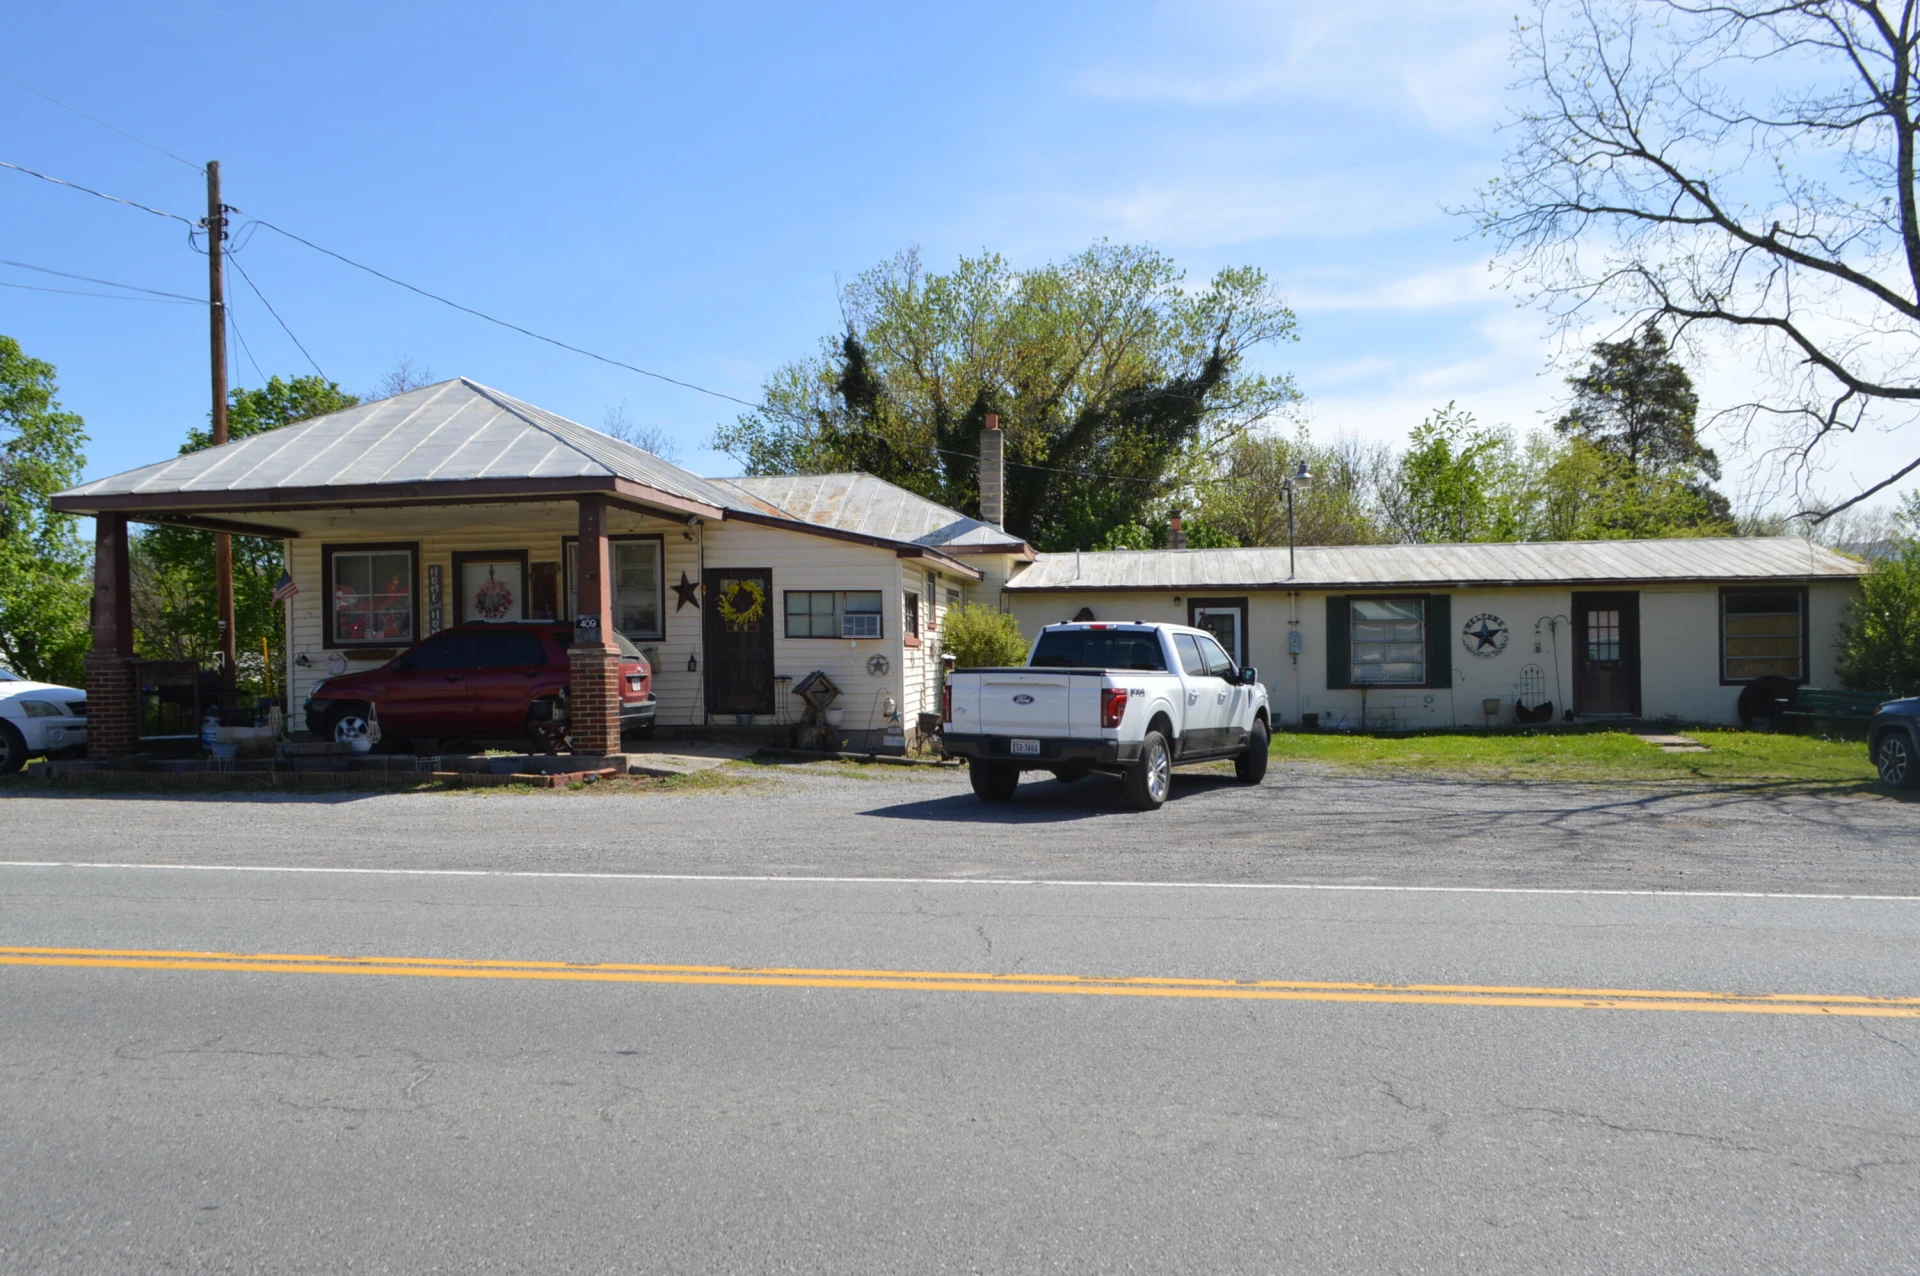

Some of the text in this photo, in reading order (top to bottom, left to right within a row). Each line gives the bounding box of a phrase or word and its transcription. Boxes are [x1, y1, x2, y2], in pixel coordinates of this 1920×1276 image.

[430, 566, 439, 602] HOME
[431, 609, 440, 635] HOM
[580, 619, 597, 628] 409
[1464, 613, 1505, 629] WELCOME
[1015, 695, 1032, 704] Ford
